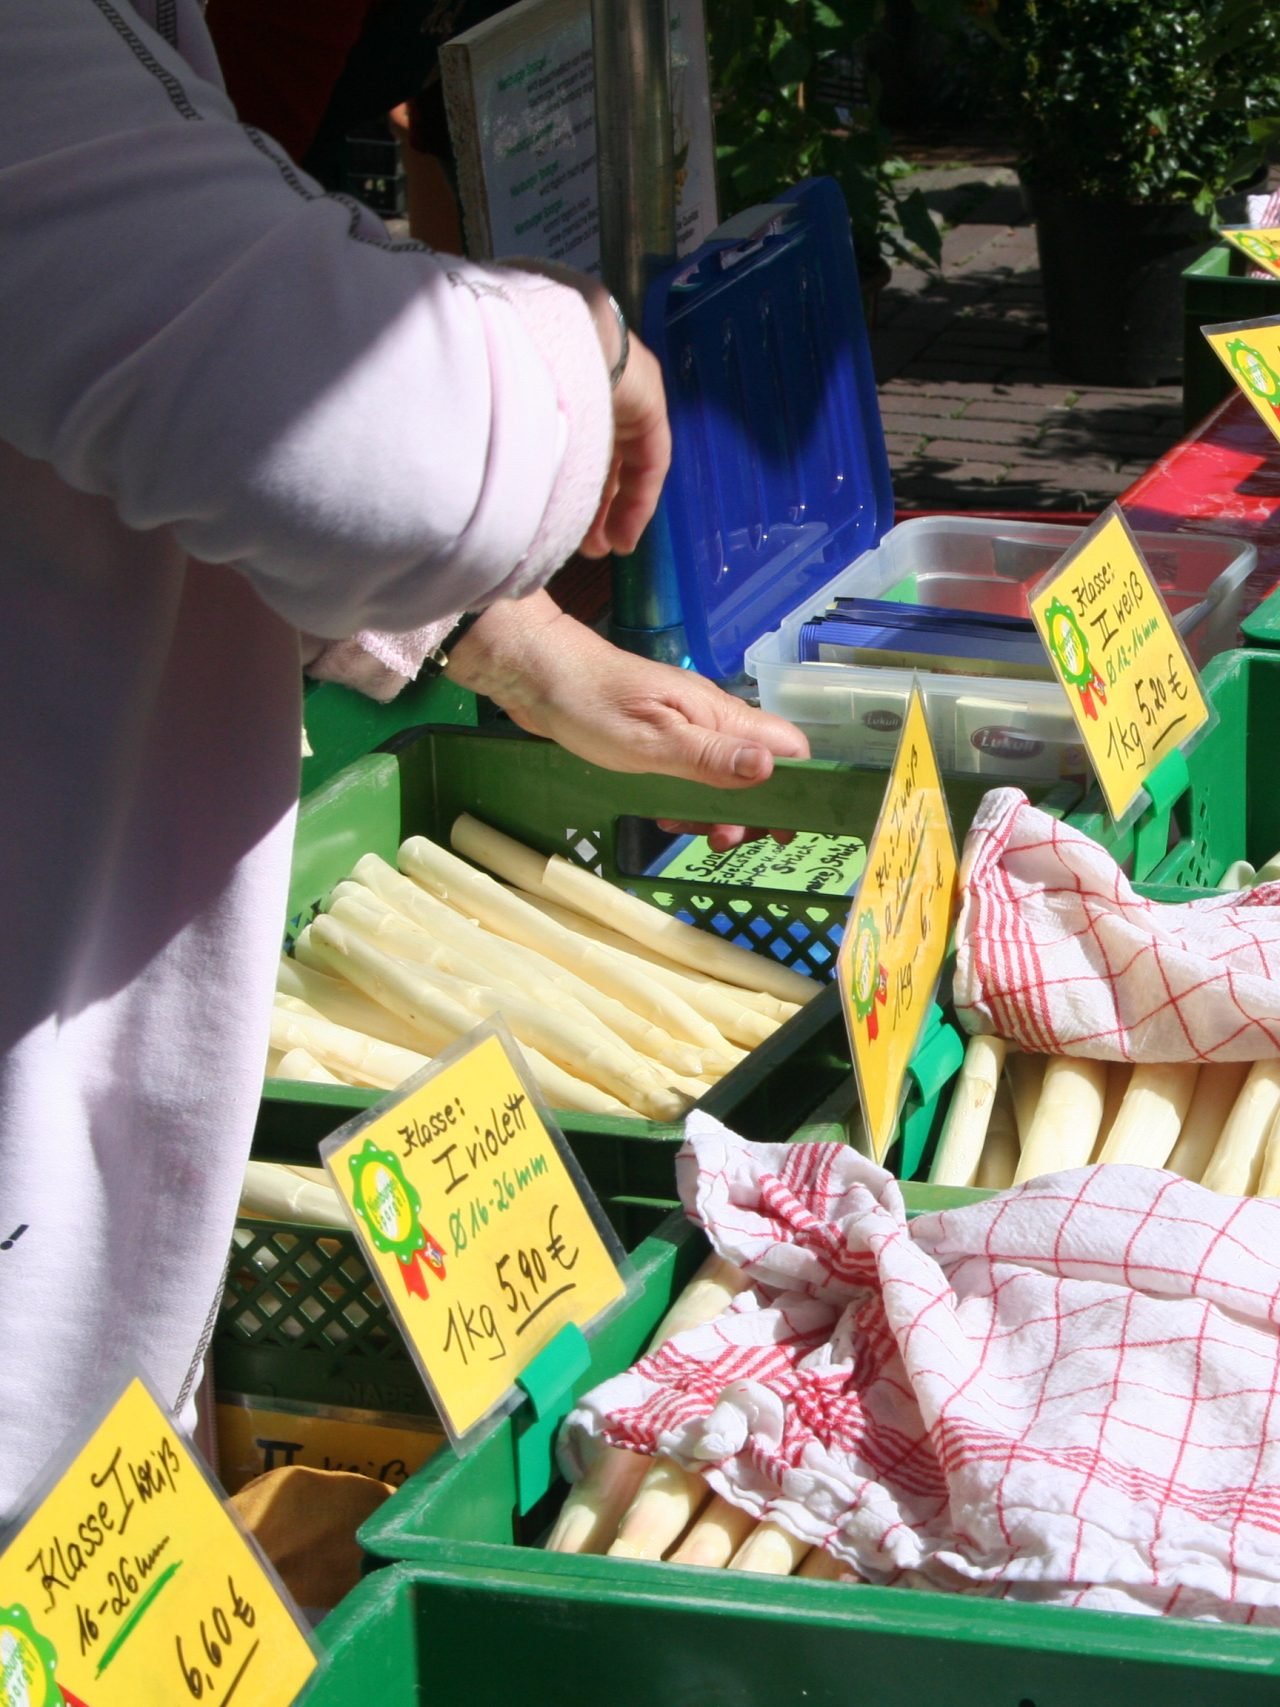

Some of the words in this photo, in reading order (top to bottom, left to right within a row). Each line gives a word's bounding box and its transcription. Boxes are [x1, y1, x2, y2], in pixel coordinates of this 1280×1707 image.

[1090, 609, 1119, 652] II
[1113, 571, 1143, 625] weiß
[1107, 716, 1146, 771] 1kg
[432, 1144, 468, 1194] I
[468, 1094, 530, 1171] violett
[443, 1300, 506, 1366] 1kg
[26, 1500, 115, 1613] Klasse
[91, 1447, 134, 1535] I
[129, 1437, 181, 1504] weiß
